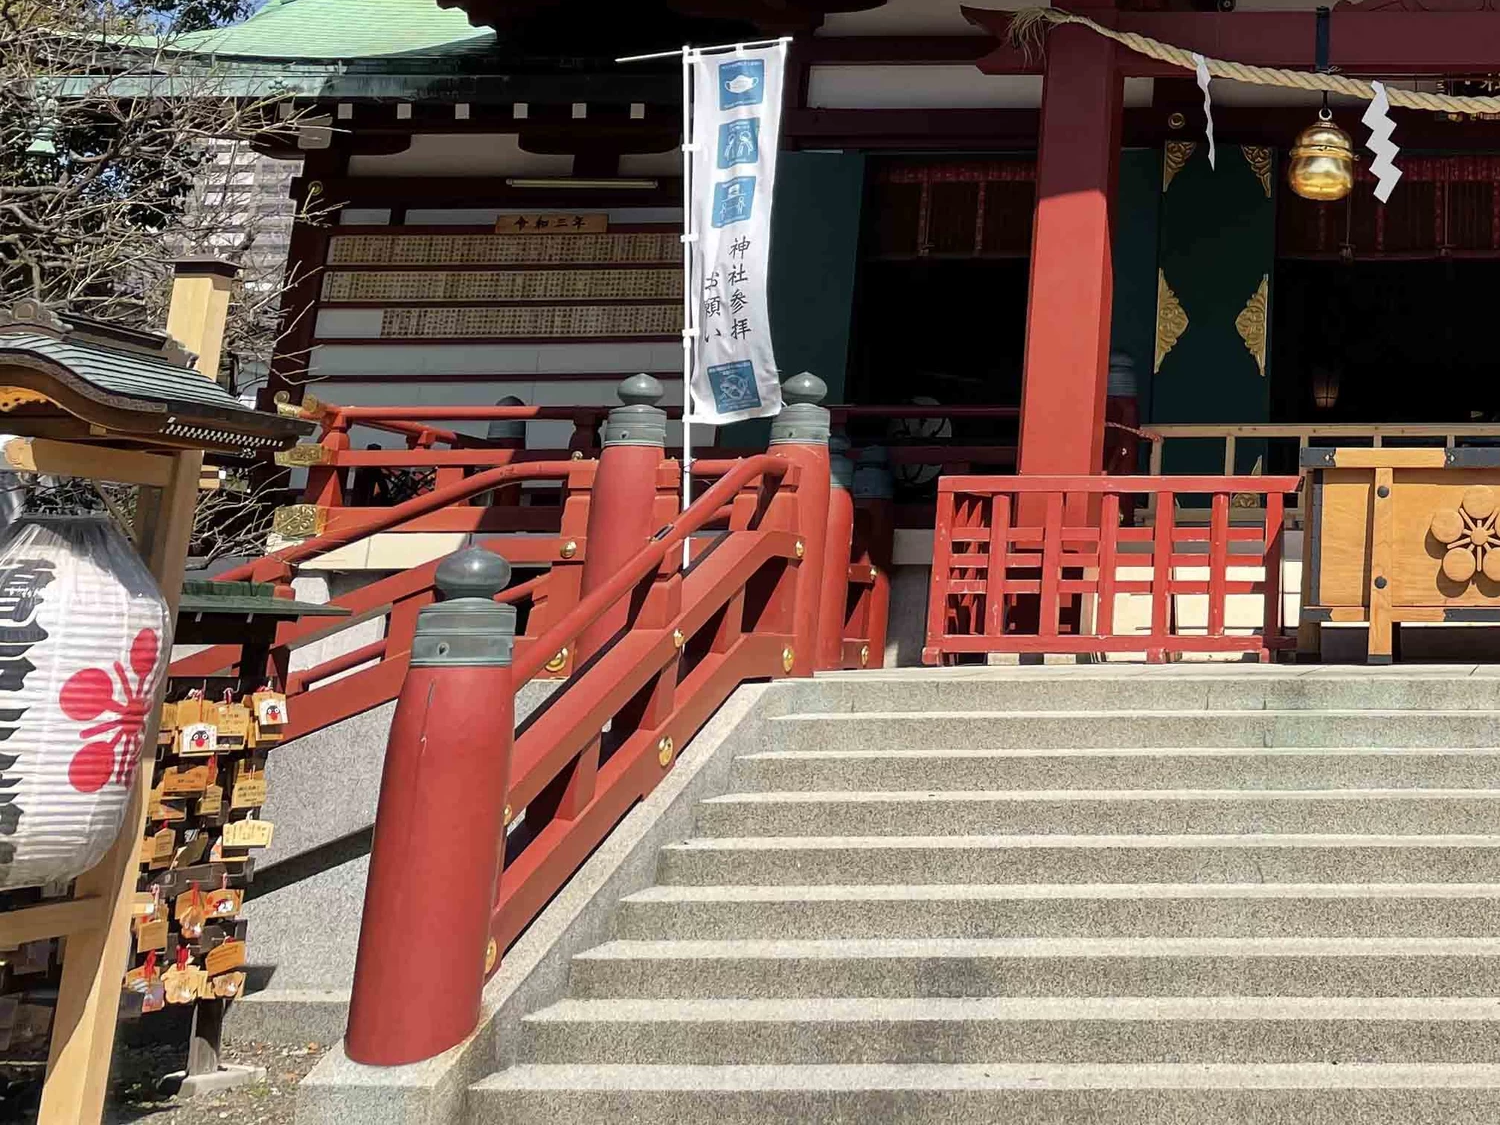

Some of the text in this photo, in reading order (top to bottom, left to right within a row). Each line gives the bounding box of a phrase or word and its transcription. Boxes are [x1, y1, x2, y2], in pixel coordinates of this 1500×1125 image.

[514, 215, 586, 231] 令和三年
[728, 235, 752, 340] 神社参拝
